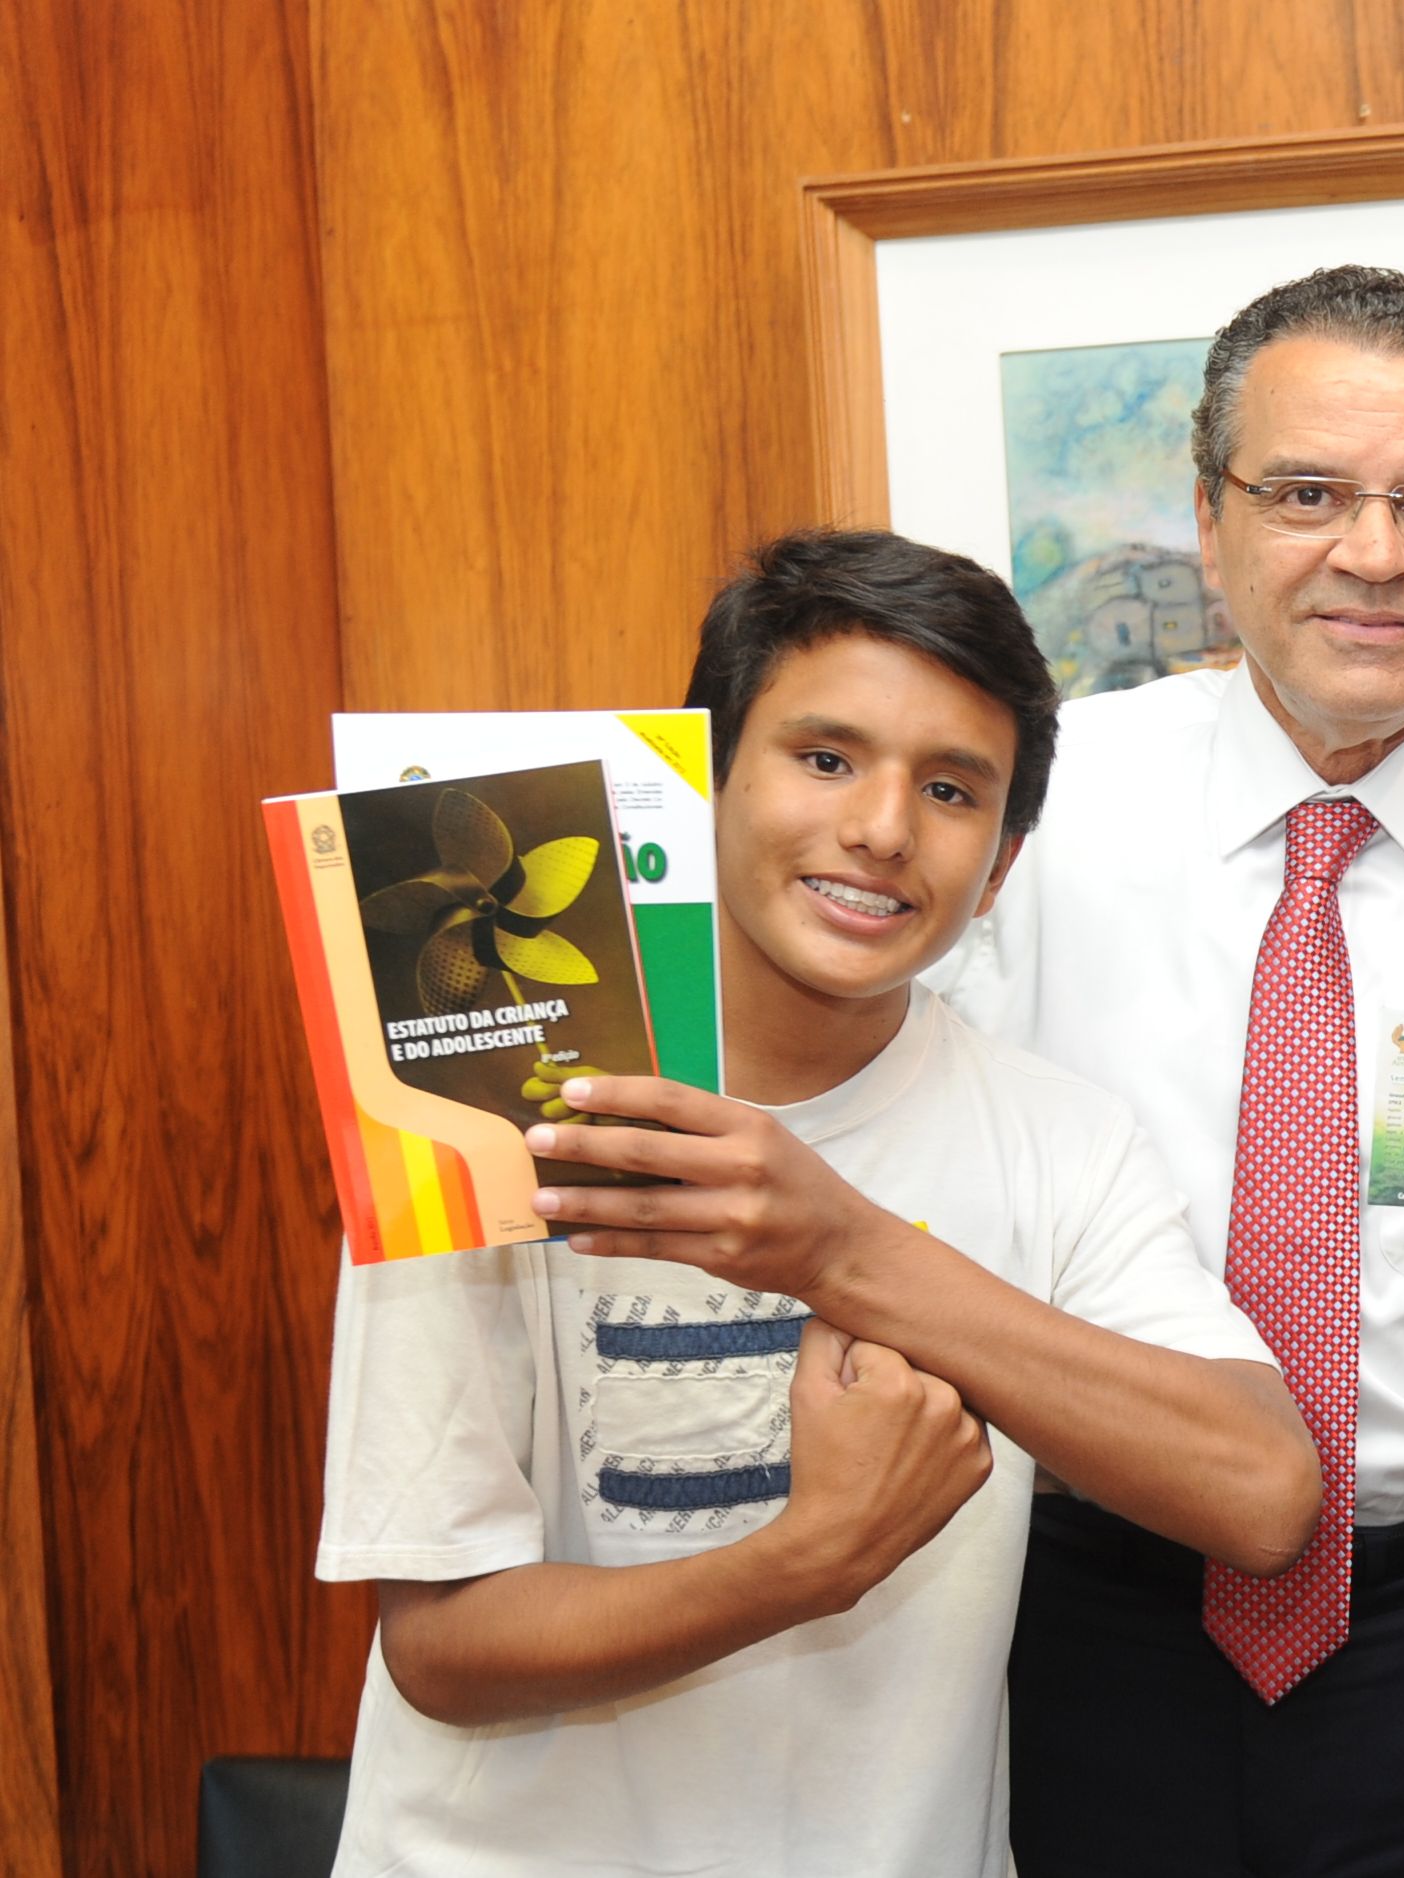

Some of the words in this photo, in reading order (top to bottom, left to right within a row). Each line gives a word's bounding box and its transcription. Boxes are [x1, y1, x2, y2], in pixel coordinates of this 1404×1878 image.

[387, 1012, 468, 1040] ESTATUTO
[470, 1009, 495, 1029] DA
[495, 999, 569, 1023] CRIANÇA
[391, 1044, 404, 1061] E
[405, 1041, 430, 1060] DO
[431, 1025, 546, 1057] ADOLESCENTE
